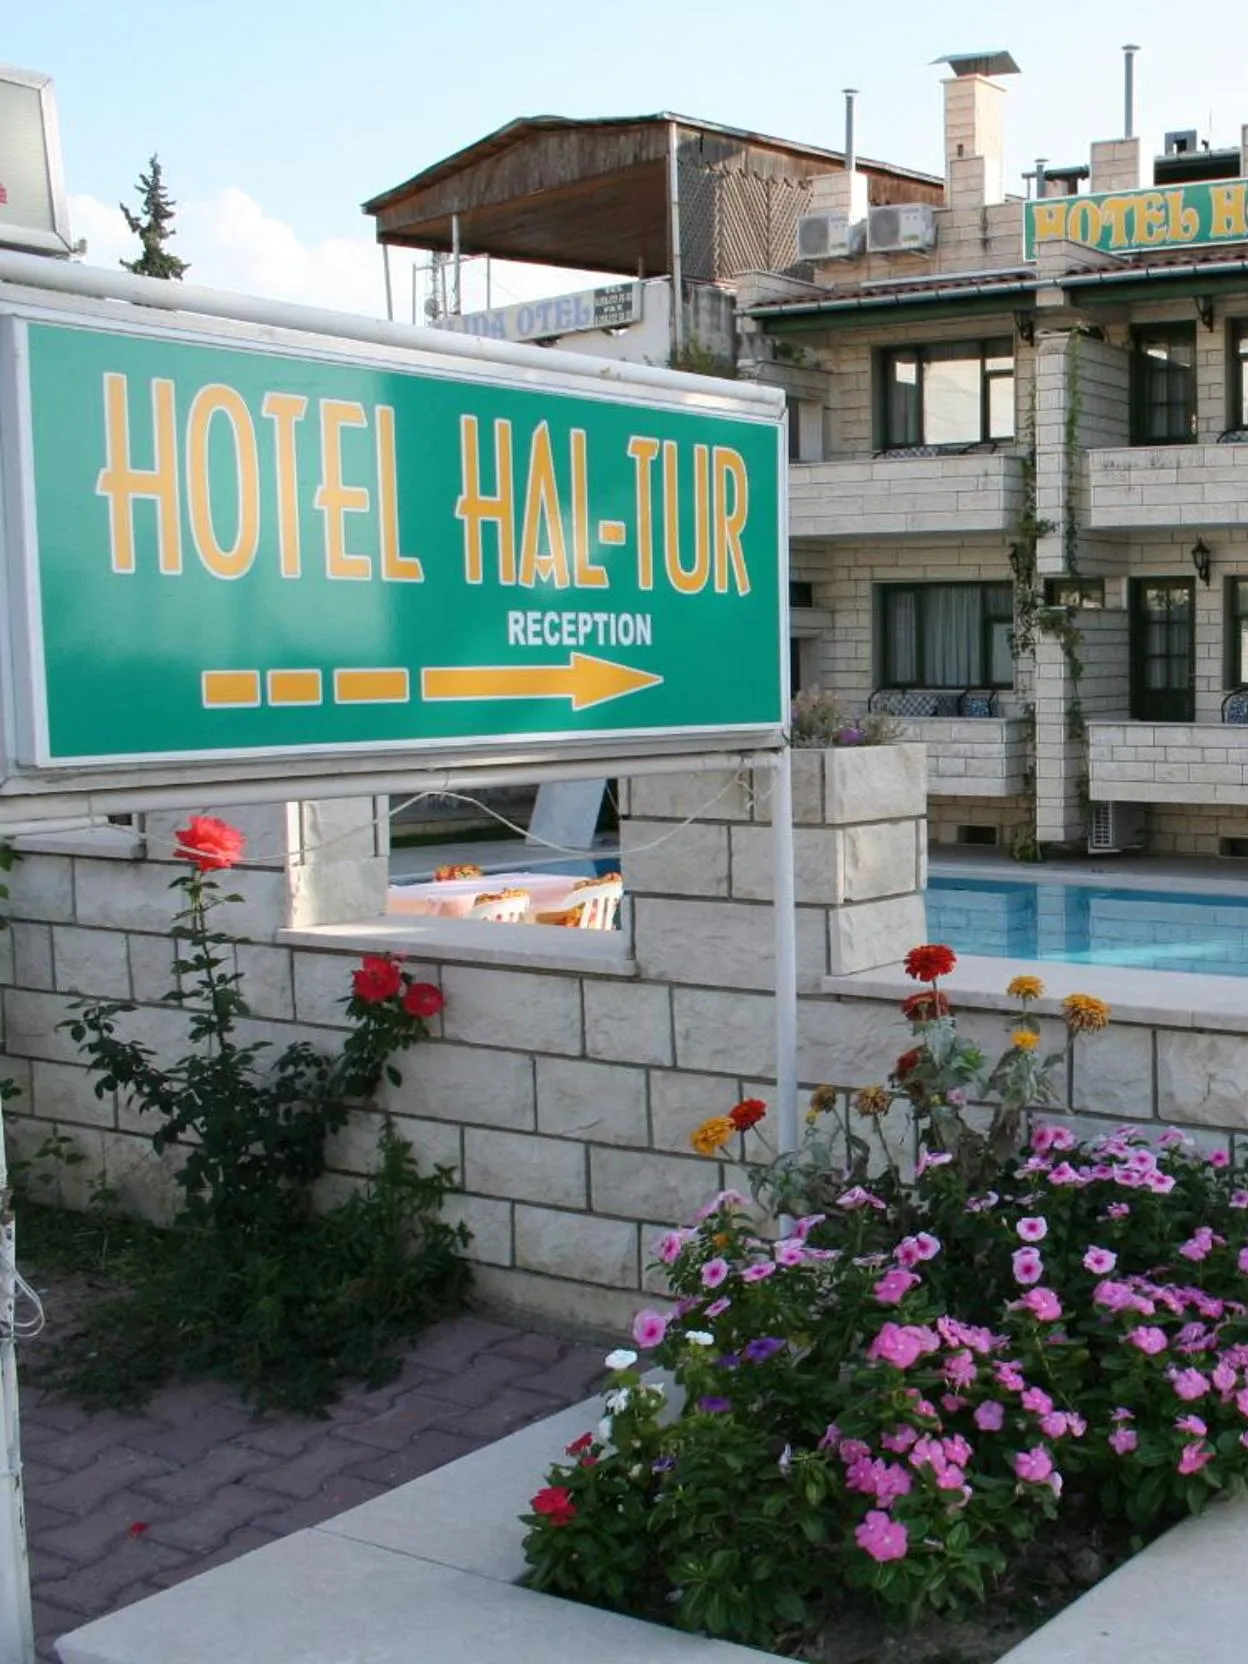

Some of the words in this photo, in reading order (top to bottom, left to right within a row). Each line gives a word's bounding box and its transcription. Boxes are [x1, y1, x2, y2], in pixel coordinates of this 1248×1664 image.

[1033, 190, 1200, 254] HOTEL
[516, 297, 591, 334] OTEL
[96, 372, 424, 582] HOTEL
[455, 414, 751, 597] HAL-TUR
[507, 610, 653, 646] RECEPTION
